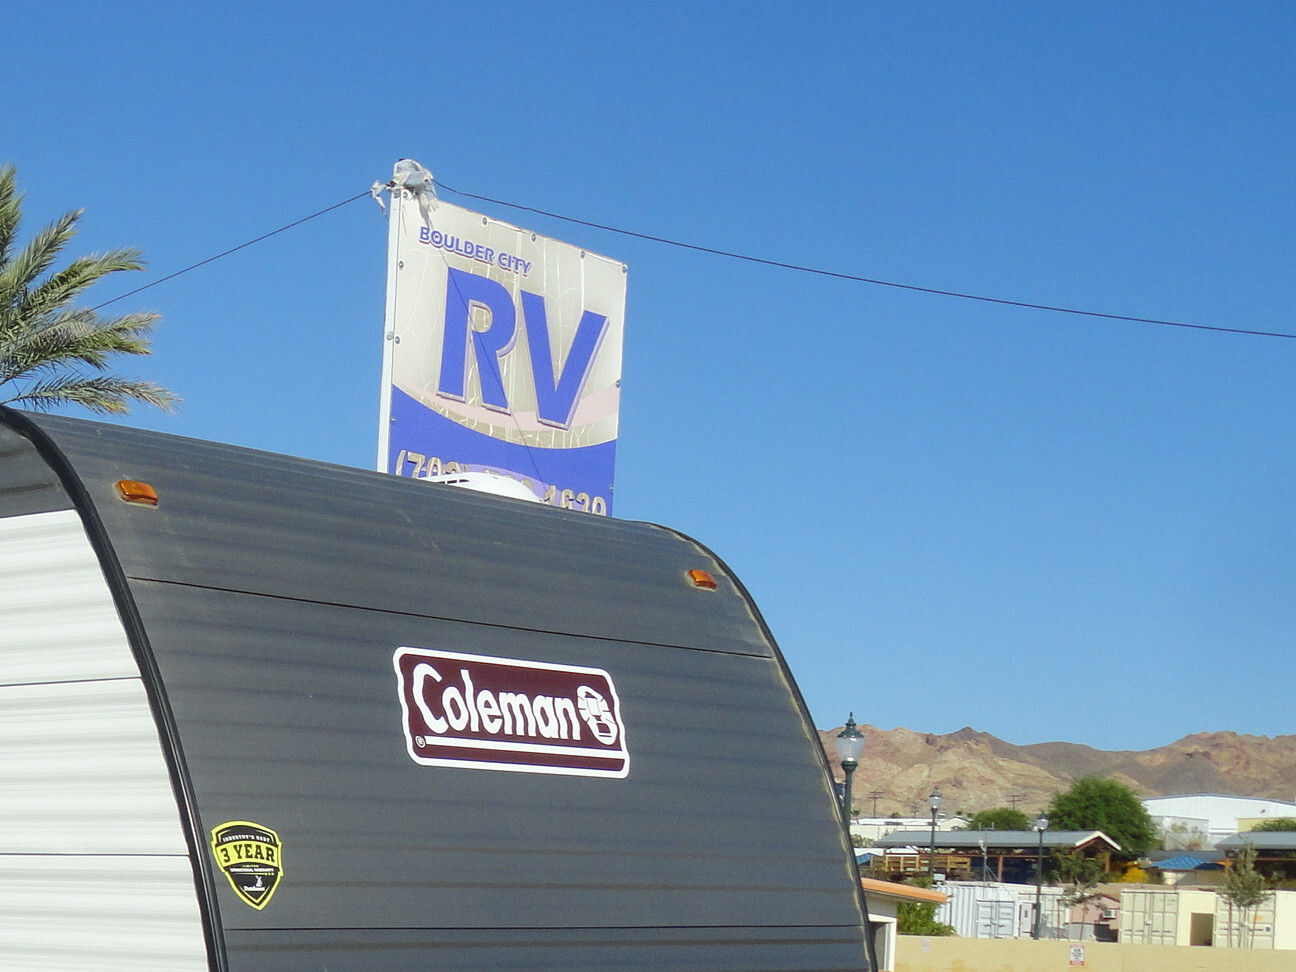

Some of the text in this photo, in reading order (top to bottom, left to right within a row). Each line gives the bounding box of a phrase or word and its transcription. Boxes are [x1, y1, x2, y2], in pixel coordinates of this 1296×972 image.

[419, 226, 532, 277] BOULDER CITY
[436, 266, 610, 431] RV
[412, 663, 581, 741] Coleman
[220, 843, 276, 864] 3 YEAR
